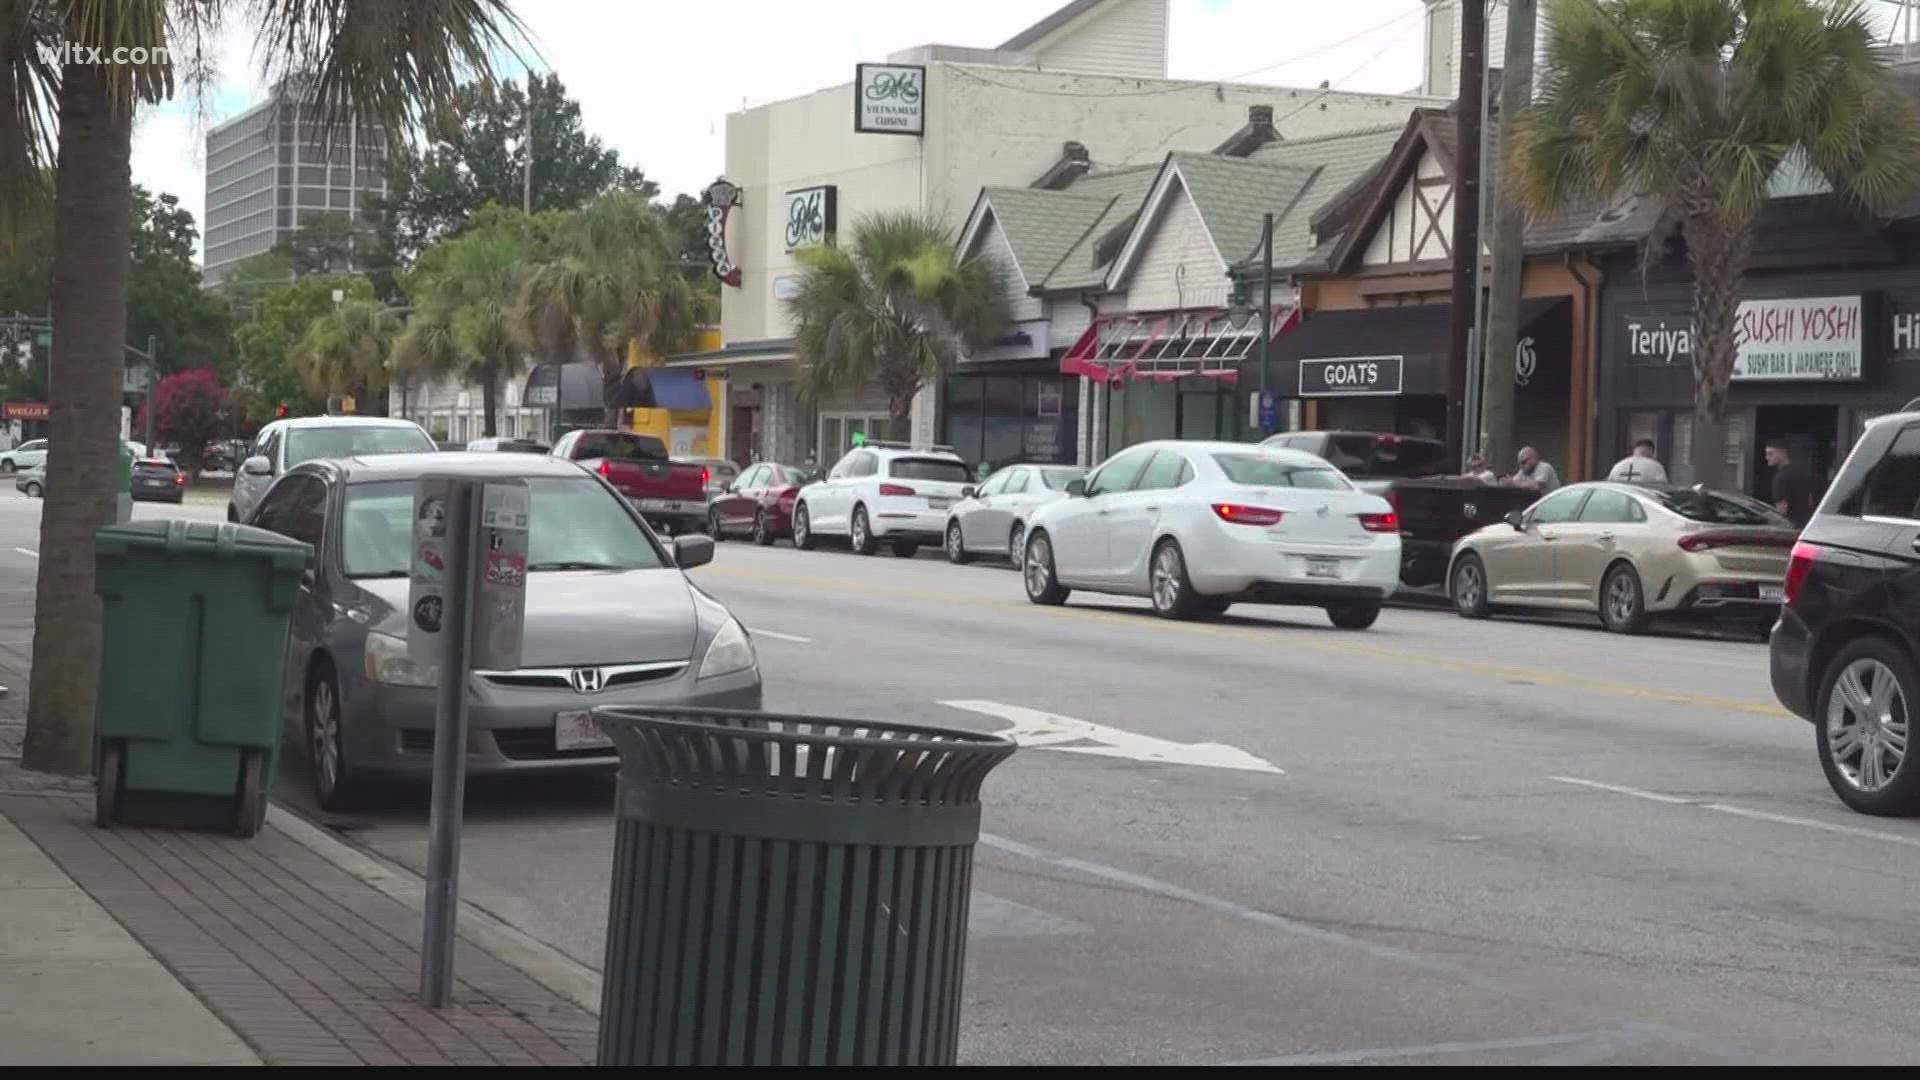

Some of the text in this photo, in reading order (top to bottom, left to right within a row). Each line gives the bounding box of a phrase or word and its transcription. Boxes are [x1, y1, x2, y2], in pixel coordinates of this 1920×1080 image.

[866, 105, 918, 116] VIETNAMESE
[875, 116, 908, 127] CUISINE
[1743, 305, 1858, 343] SUSHI YOSHI
[1747, 353, 1769, 375] SUSHI
[1770, 352, 1786, 374] BAR
[1795, 351, 1834, 374] JAPANESE
[1834, 351, 1858, 374] GRILL
